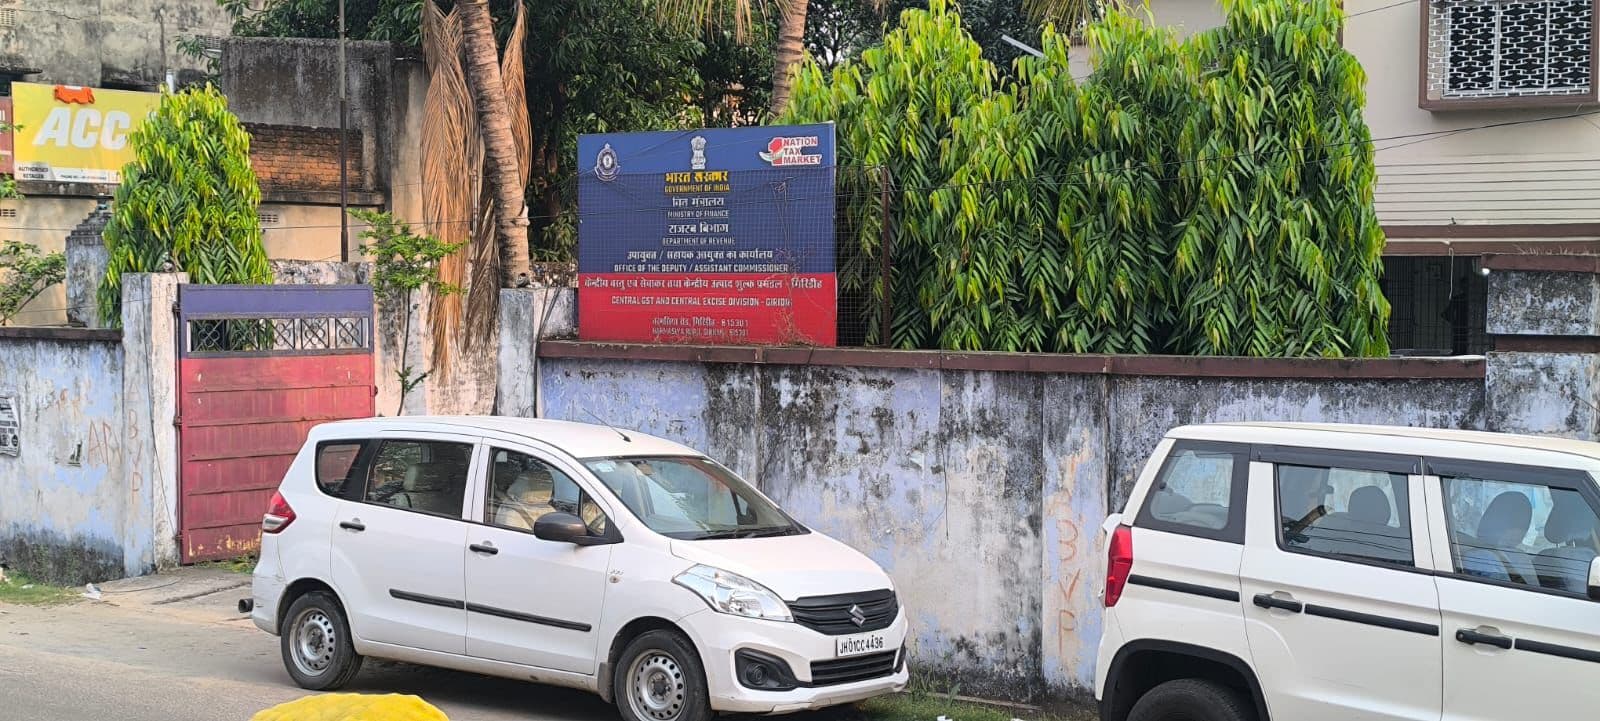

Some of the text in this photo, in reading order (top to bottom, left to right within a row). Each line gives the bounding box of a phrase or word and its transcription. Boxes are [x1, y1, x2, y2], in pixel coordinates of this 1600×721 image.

[32, 106, 131, 150] ACC
[783, 137, 817, 147] NATION
[783, 147, 801, 155] TAX
[783, 156, 821, 164] MARKET
[665, 171, 728, 183] भारत सरकार
[664, 183, 730, 193] GOVERNMENT OF INDIA
[667, 210, 694, 218] MINISTRY
[704, 209, 729, 217] FINANCE
[700, 221, 728, 233] विभाग
[662, 236, 736, 245] DEPARTMENT OF REVENUE
[659, 250, 664, 260] /
[666, 251, 694, 260] सहायक
[726, 250, 737, 259] का
[738, 247, 774, 259] कार्यालय
[614, 263, 788, 272] OFFICE OF THE DEPUTY / ASSISTANT COMMISSIONER
[611, 295, 640, 304] CENTRAL
[641, 296, 654, 305] GST
[655, 296, 670, 305] AND
[671, 296, 700, 305] CENTRAL
[703, 297, 726, 306] EXCISE
[728, 297, 760, 306] DIVISION
